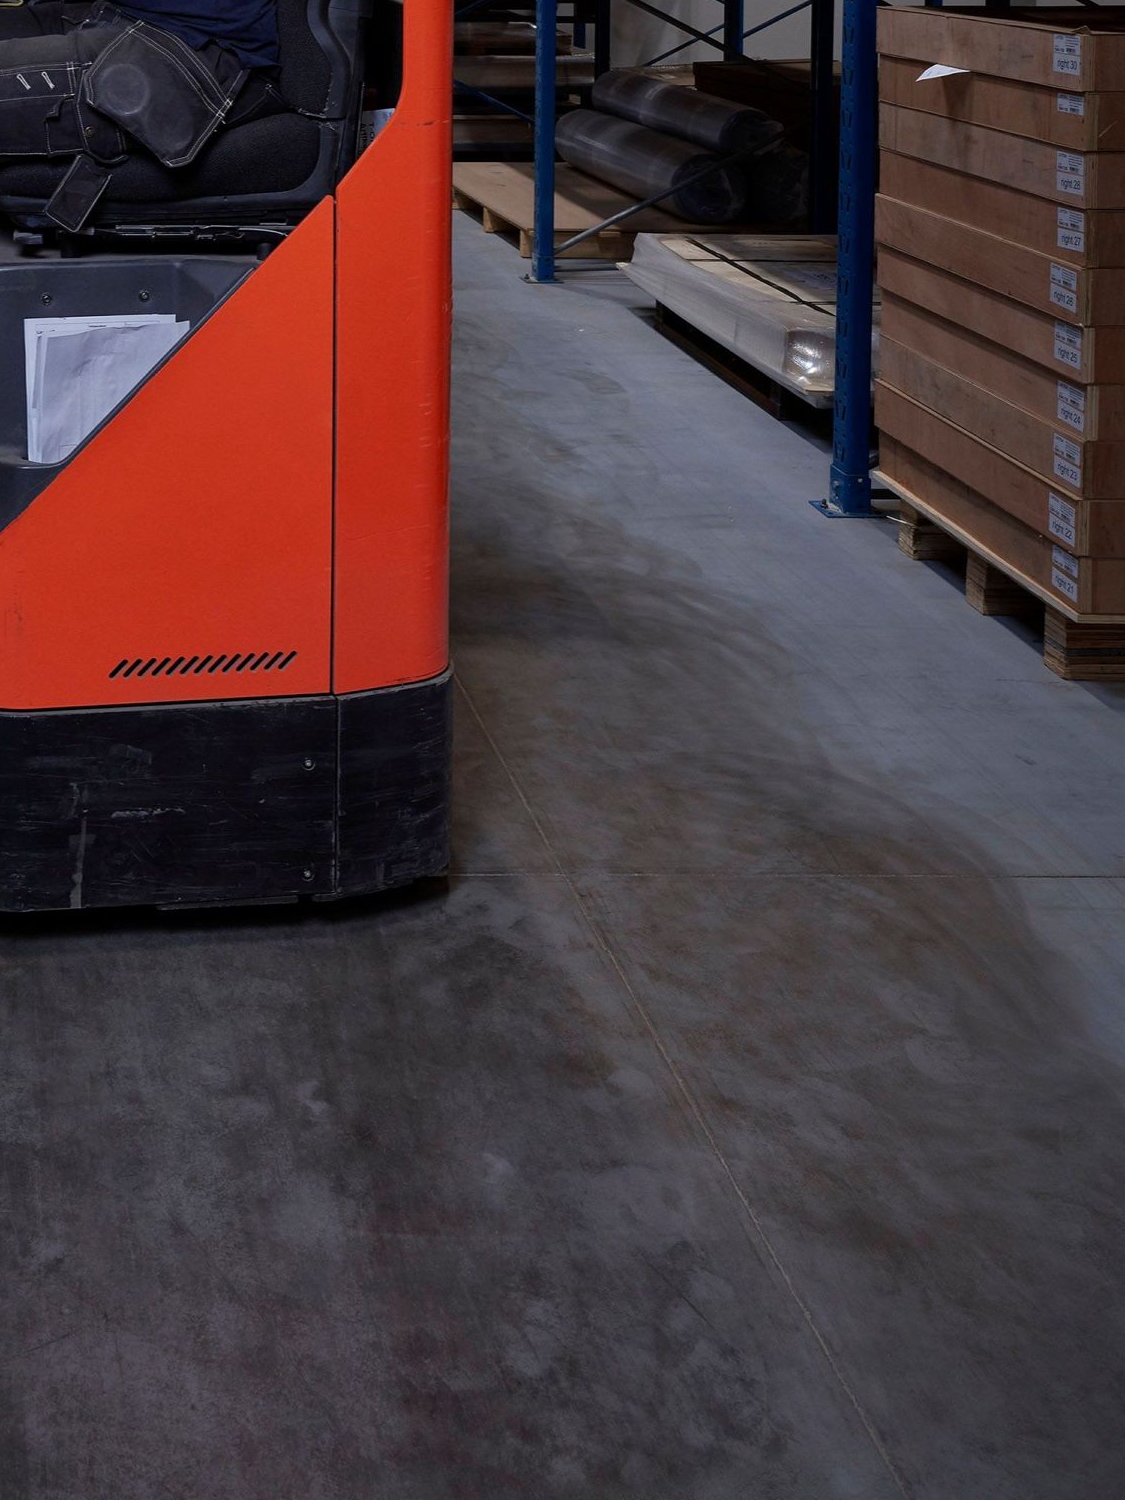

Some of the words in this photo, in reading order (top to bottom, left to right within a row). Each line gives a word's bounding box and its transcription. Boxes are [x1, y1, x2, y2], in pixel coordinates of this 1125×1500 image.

[1069, 60, 1078, 70] 30
[1072, 180, 1081, 190] 28
[1073, 236, 1082, 246] 27
[1070, 351, 1078, 364] 25
[1073, 413, 1081, 425] 24
[1064, 527, 1073, 540] 22
